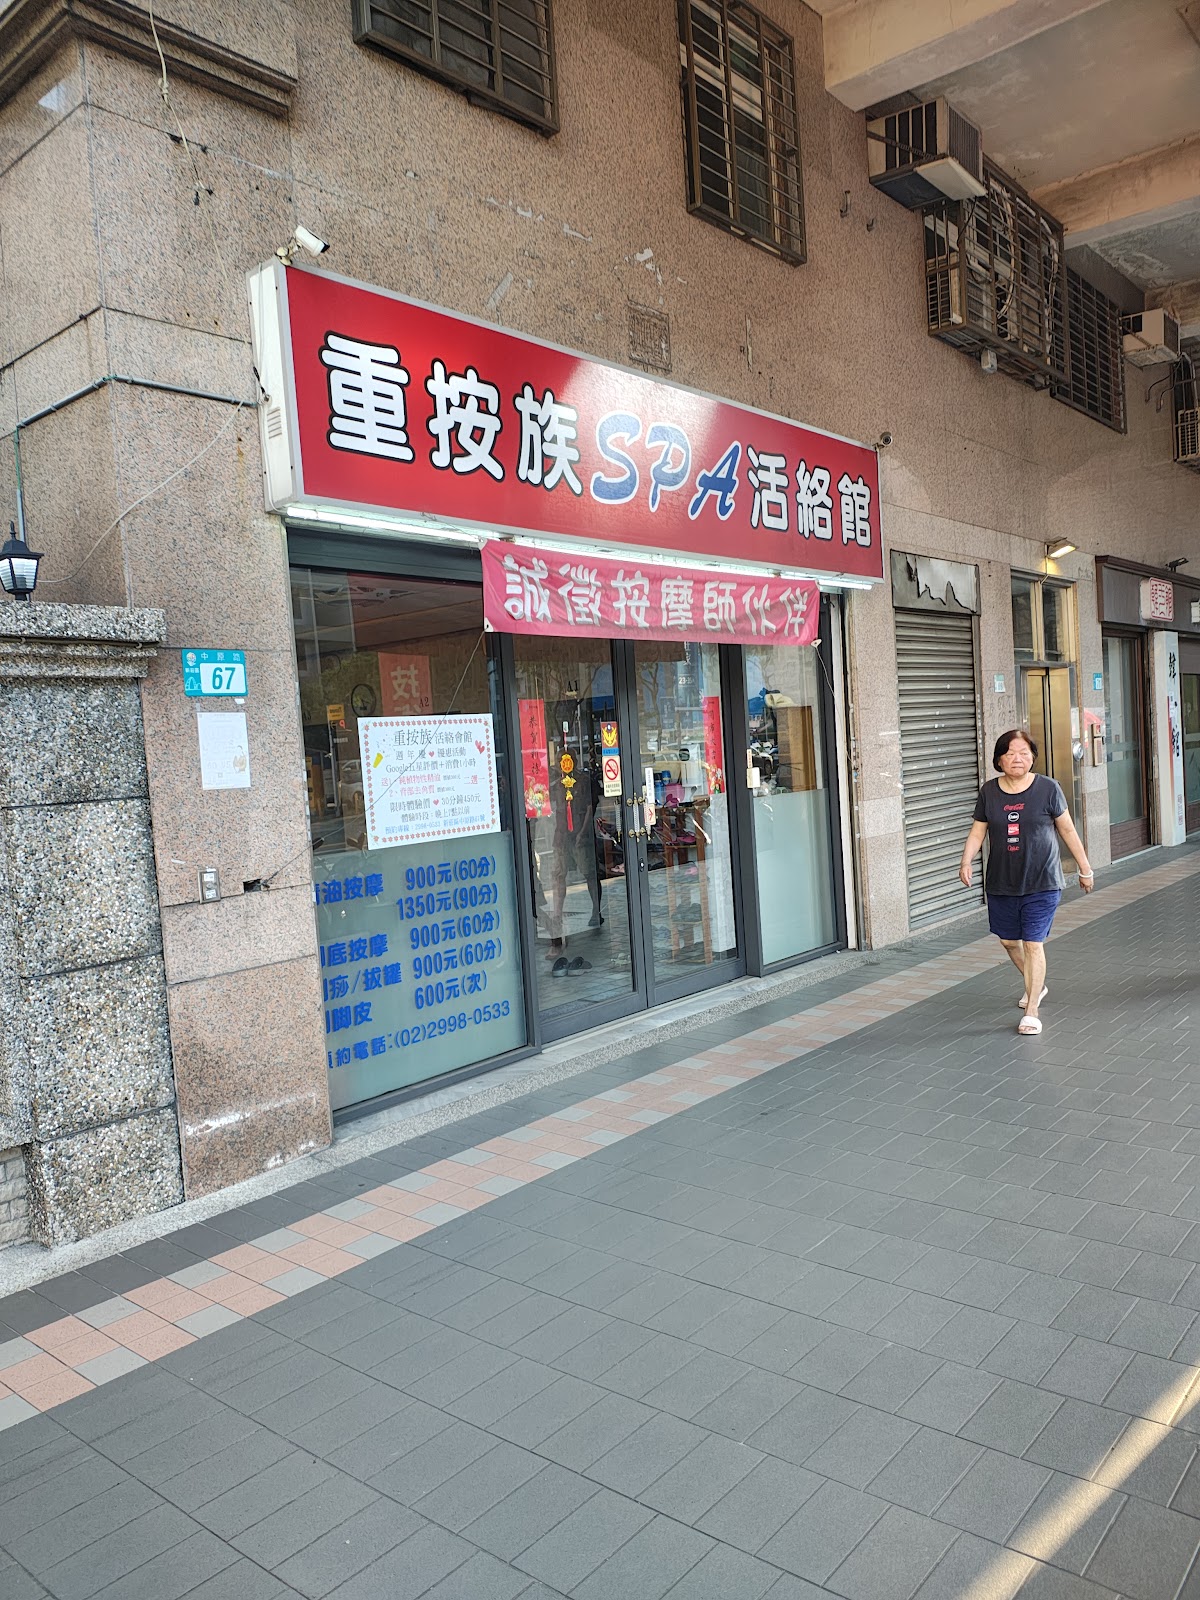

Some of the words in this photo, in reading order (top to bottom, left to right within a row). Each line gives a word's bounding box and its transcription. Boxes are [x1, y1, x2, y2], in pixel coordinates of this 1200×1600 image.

[318, 330, 872, 549] 重按族SPA活絡館
[502, 554, 809, 637] 誠徵按摩師伙伴
[212, 667, 236, 690] 67
[393, 729, 432, 746] 重按族
[435, 731, 473, 744] 活絡會館
[396, 882, 498, 920] 1350元(90分)
[405, 855, 496, 891] 900元(60分)
[320, 933, 389, 968] 底按摩
[409, 909, 500, 950] 900元(60分)
[324, 962, 402, 1001] 痧/拔罐
[412, 937, 502, 980] 900元(60分)
[326, 1001, 373, 1033] 腳皮
[414, 971, 487, 1010] 600元(次)
